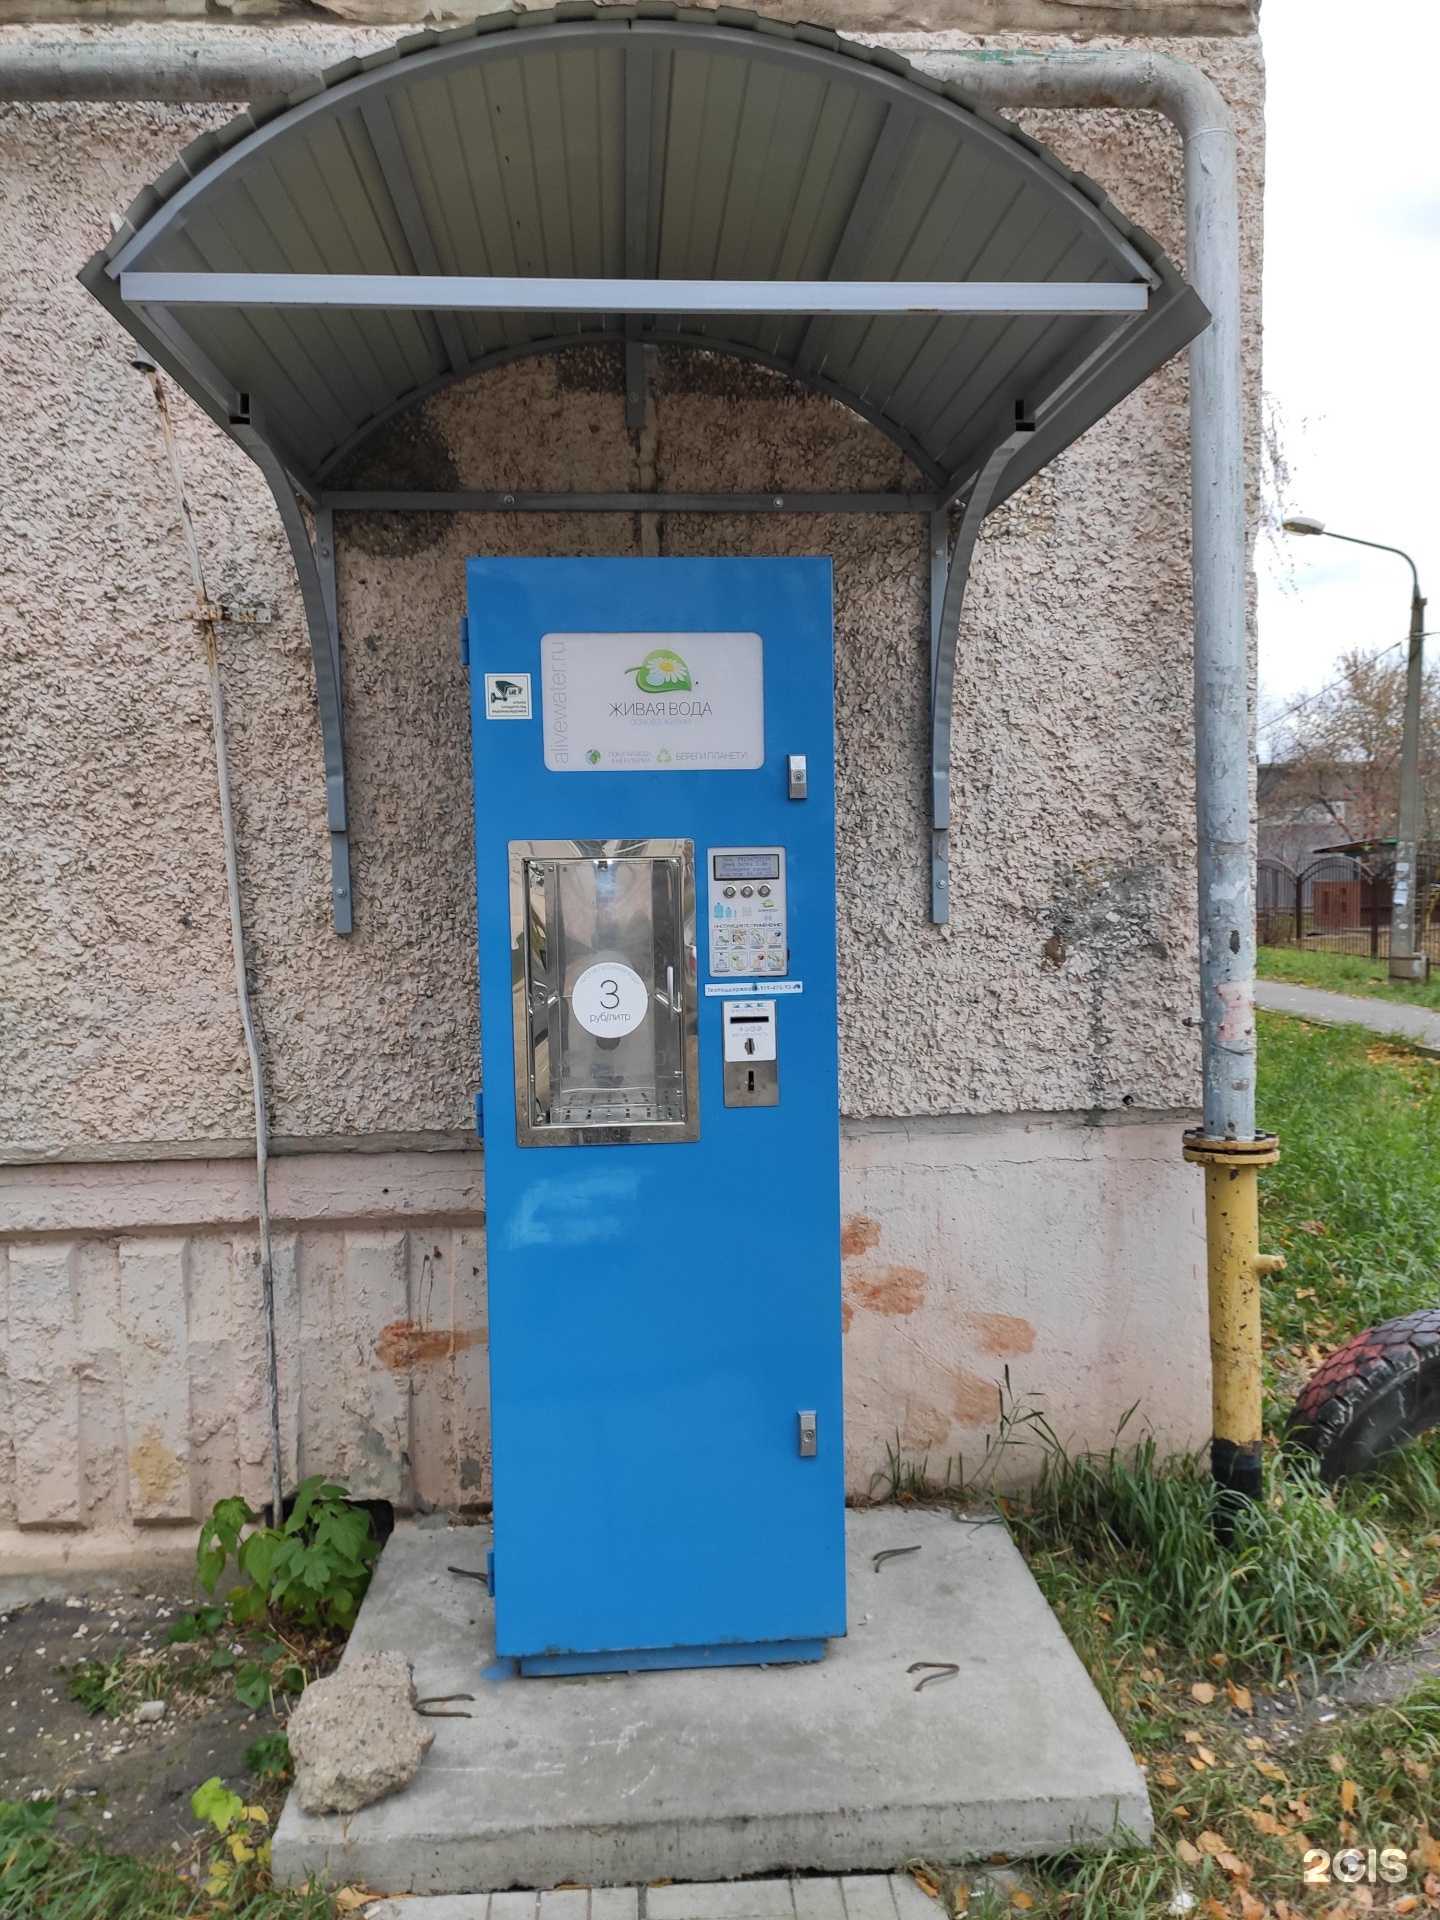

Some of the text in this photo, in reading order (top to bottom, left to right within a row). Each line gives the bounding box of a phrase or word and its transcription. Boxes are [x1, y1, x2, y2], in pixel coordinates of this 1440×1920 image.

[548, 641, 568, 764] alivewater.ru
[608, 702, 713, 717] ЖИВАЯ ВОДА
[675, 751, 707, 760] БЕРЕГИ
[600, 979, 620, 1009] 3
[590, 1011, 631, 1024] руб/литр
